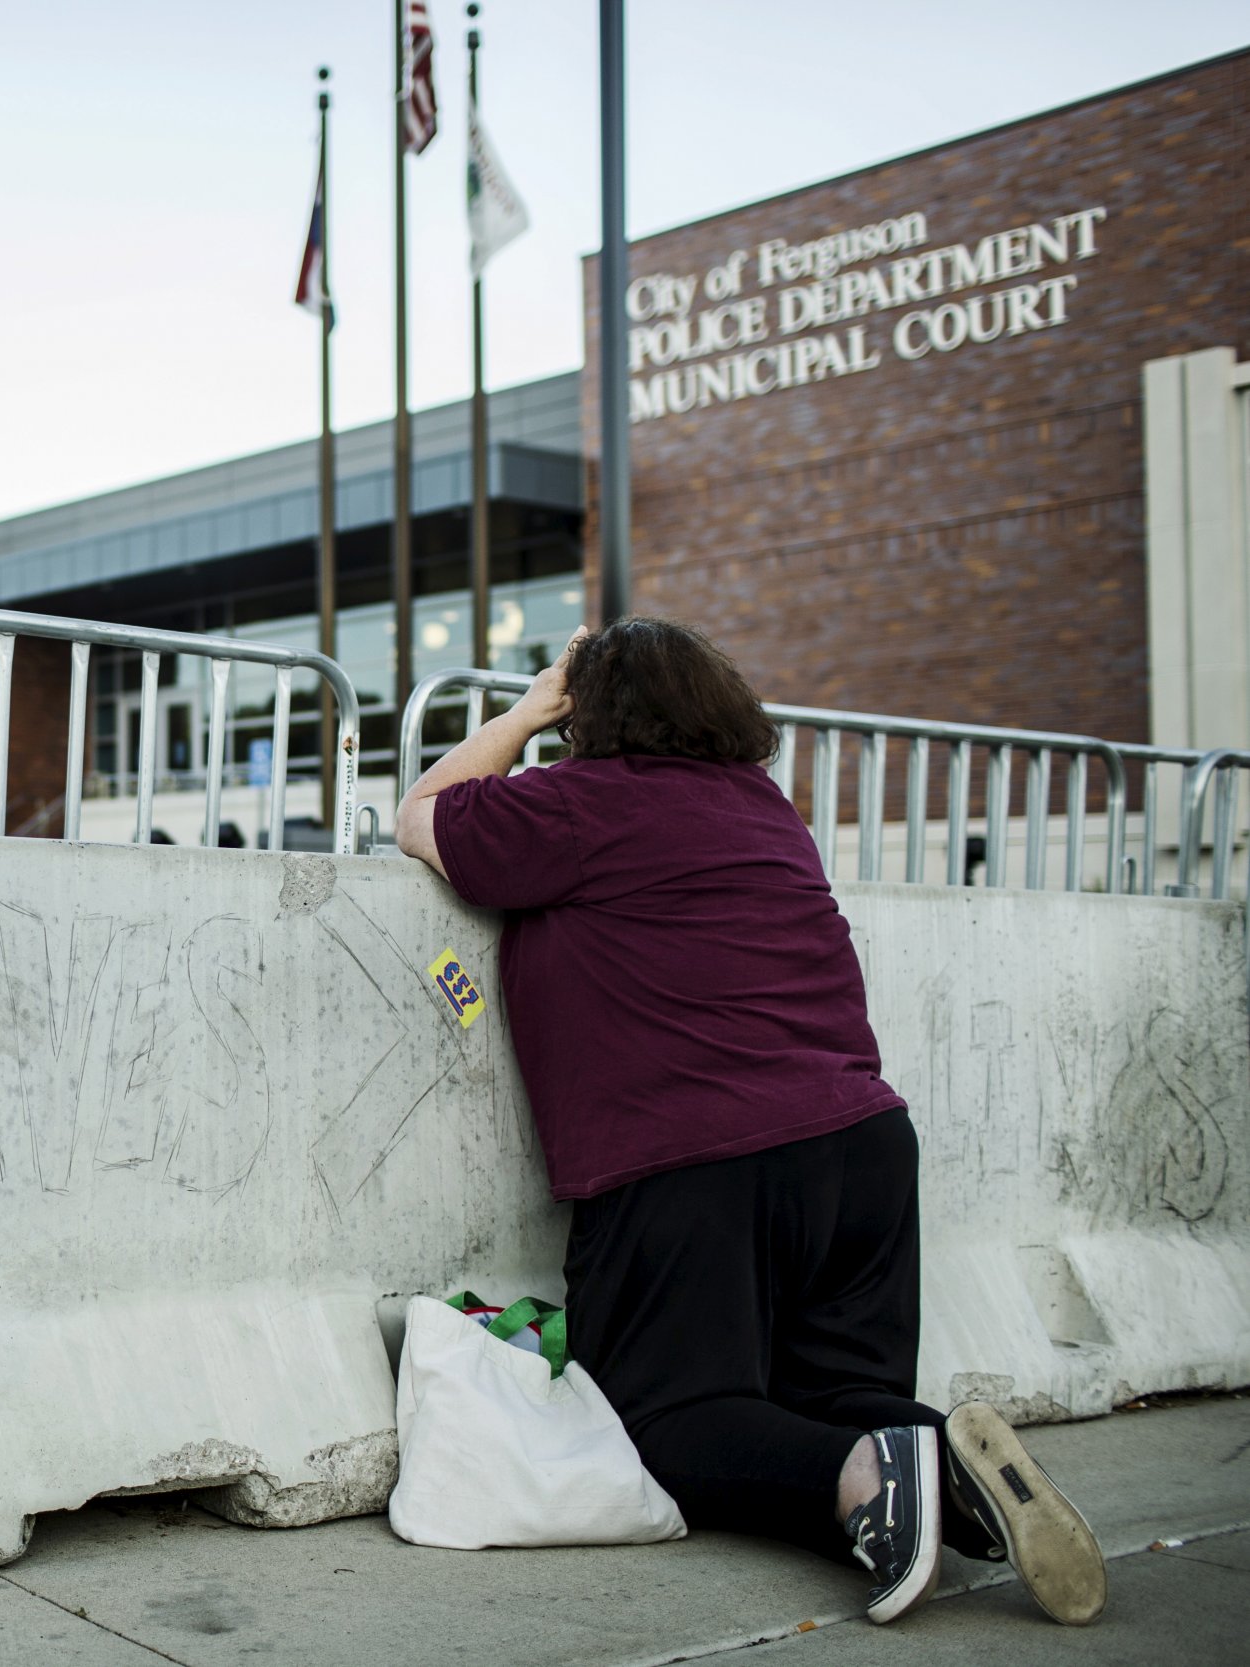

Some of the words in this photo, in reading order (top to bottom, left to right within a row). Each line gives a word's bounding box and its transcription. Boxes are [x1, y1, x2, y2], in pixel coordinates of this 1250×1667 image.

[625, 272, 698, 320] City
[704, 249, 749, 301] of
[757, 211, 927, 288] Ferguson
[628, 296, 769, 374] POLICE
[779, 206, 1107, 335] DEPARTMENT
[628, 325, 881, 424] MUNICIPAL
[894, 274, 1078, 360] COURT
